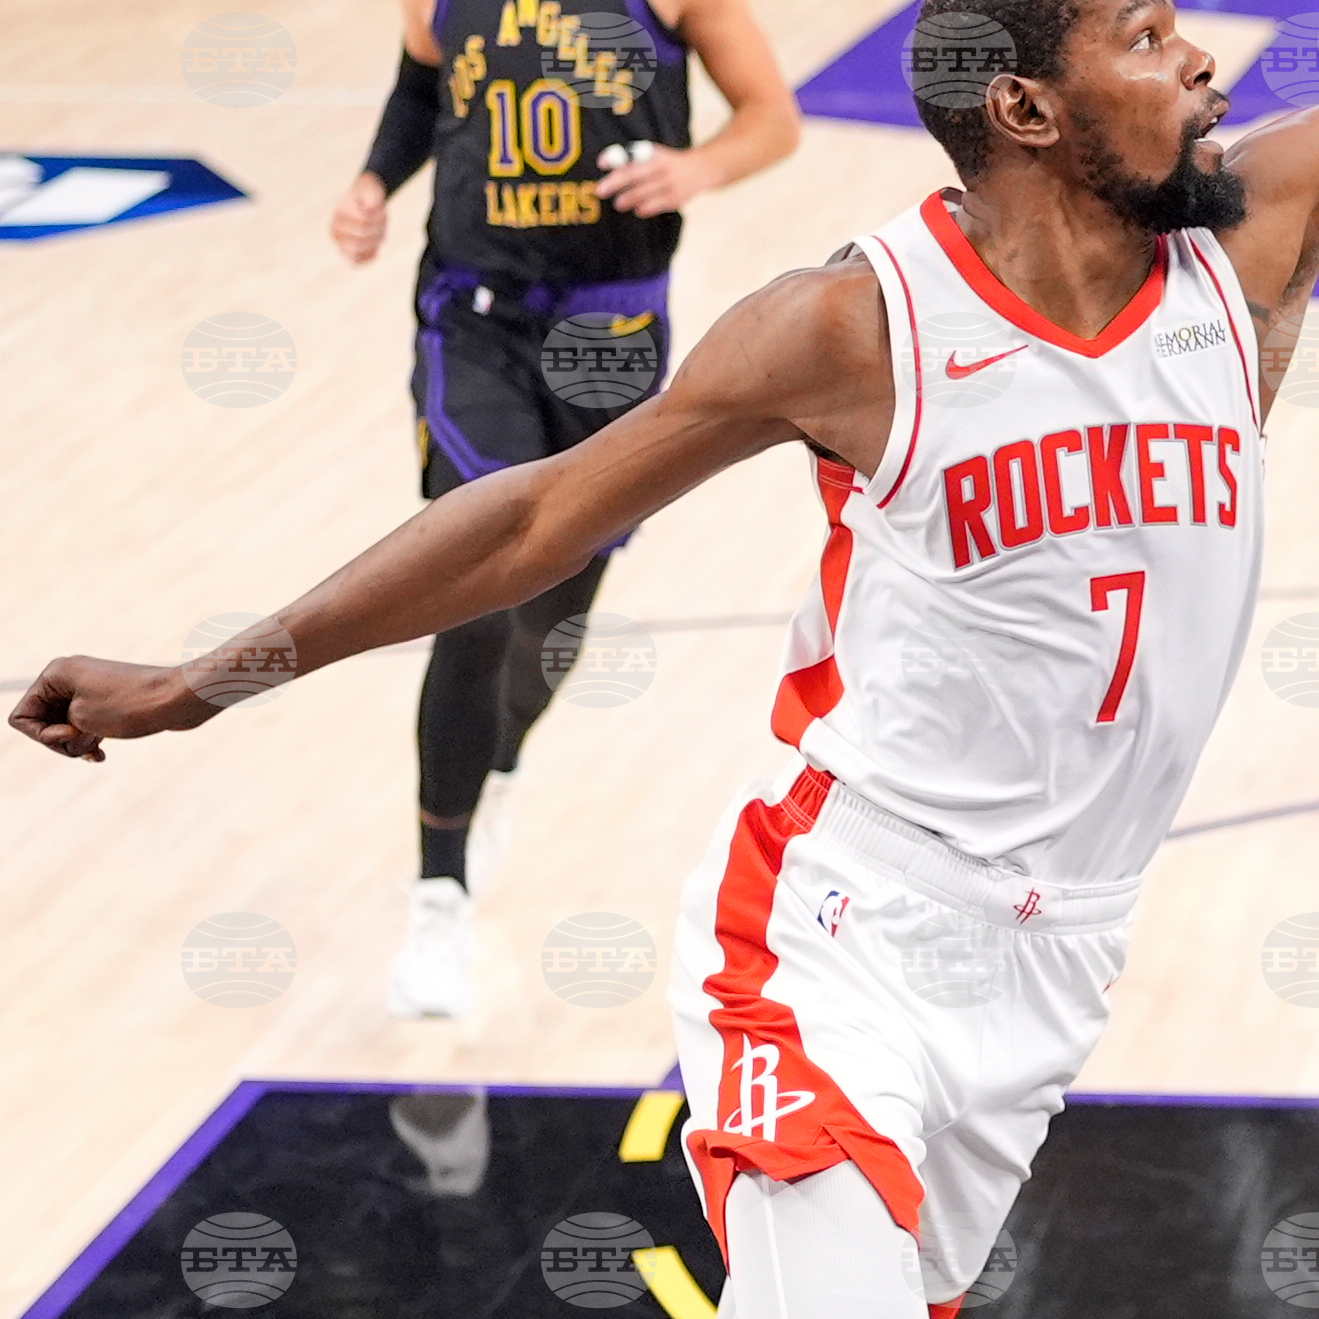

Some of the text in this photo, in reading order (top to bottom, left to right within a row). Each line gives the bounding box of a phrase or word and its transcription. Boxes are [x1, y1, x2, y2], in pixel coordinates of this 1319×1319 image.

[485, 77, 583, 178] 10
[485, 180, 602, 228] LAKERS
[1155, 319, 1226, 345] EMORIAL
[941, 421, 1242, 573] ROCKETS
[1089, 569, 1147, 725] 7
